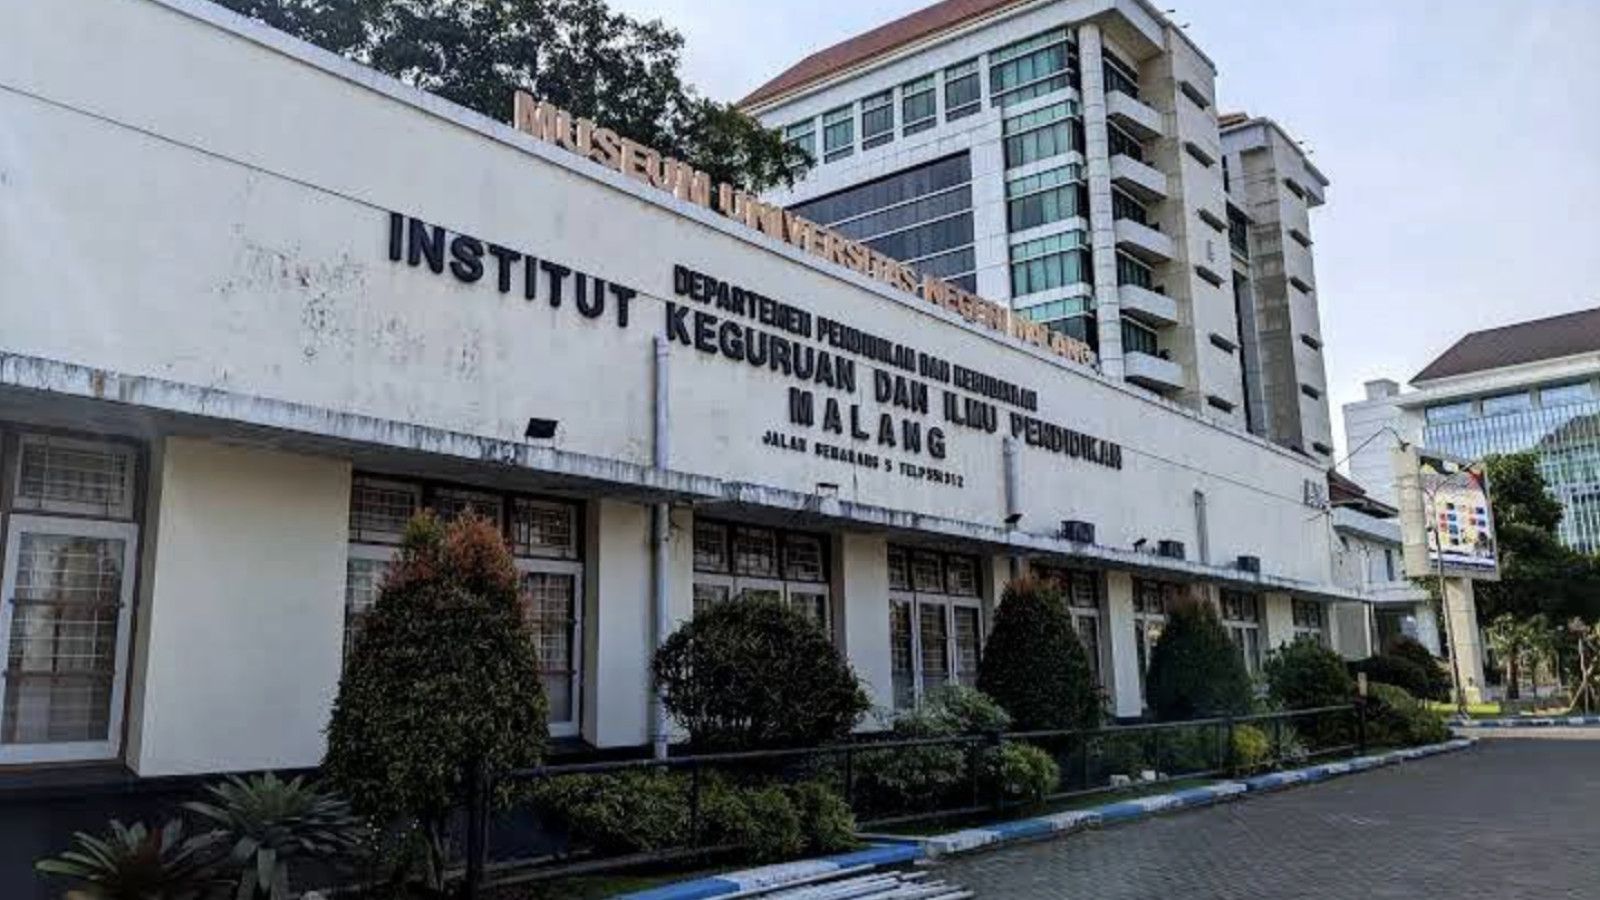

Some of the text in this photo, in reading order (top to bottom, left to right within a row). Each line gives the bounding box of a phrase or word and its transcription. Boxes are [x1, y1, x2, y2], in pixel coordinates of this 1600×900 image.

[513, 90, 1096, 366] MUSEUM UNIVERSITAS NEGERI MALANG
[389, 212, 1122, 470] INSTITUT KEGURUAN DAN ILMU PENDIDIKAN
[674, 264, 812, 338] DEPARTEMEN
[817, 316, 916, 372] PENDIDIKAN
[919, 353, 950, 383] DAN
[762, 430, 807, 452] JALAN
[815, 442, 879, 469] SEMARANG
[789, 386, 946, 459] MALANG
